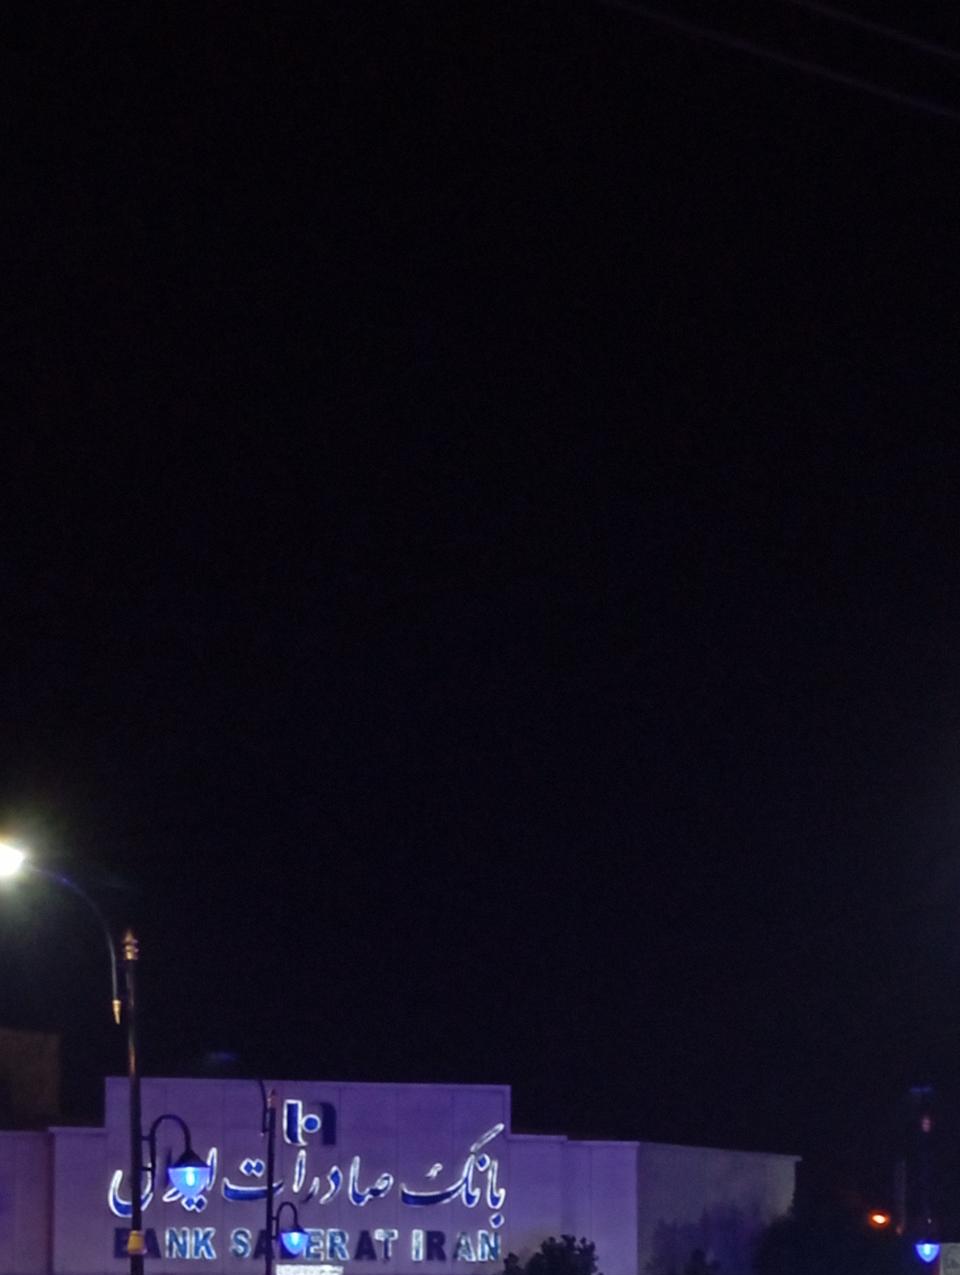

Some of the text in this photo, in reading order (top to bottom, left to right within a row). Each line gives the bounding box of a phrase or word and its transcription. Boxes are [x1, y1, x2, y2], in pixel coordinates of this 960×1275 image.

[221, 1147, 394, 1206] صادرات
[401, 1123, 506, 1229] بانک
[230, 1227, 399, 1262] SAERAT
[411, 1228, 500, 1262] IRAN
